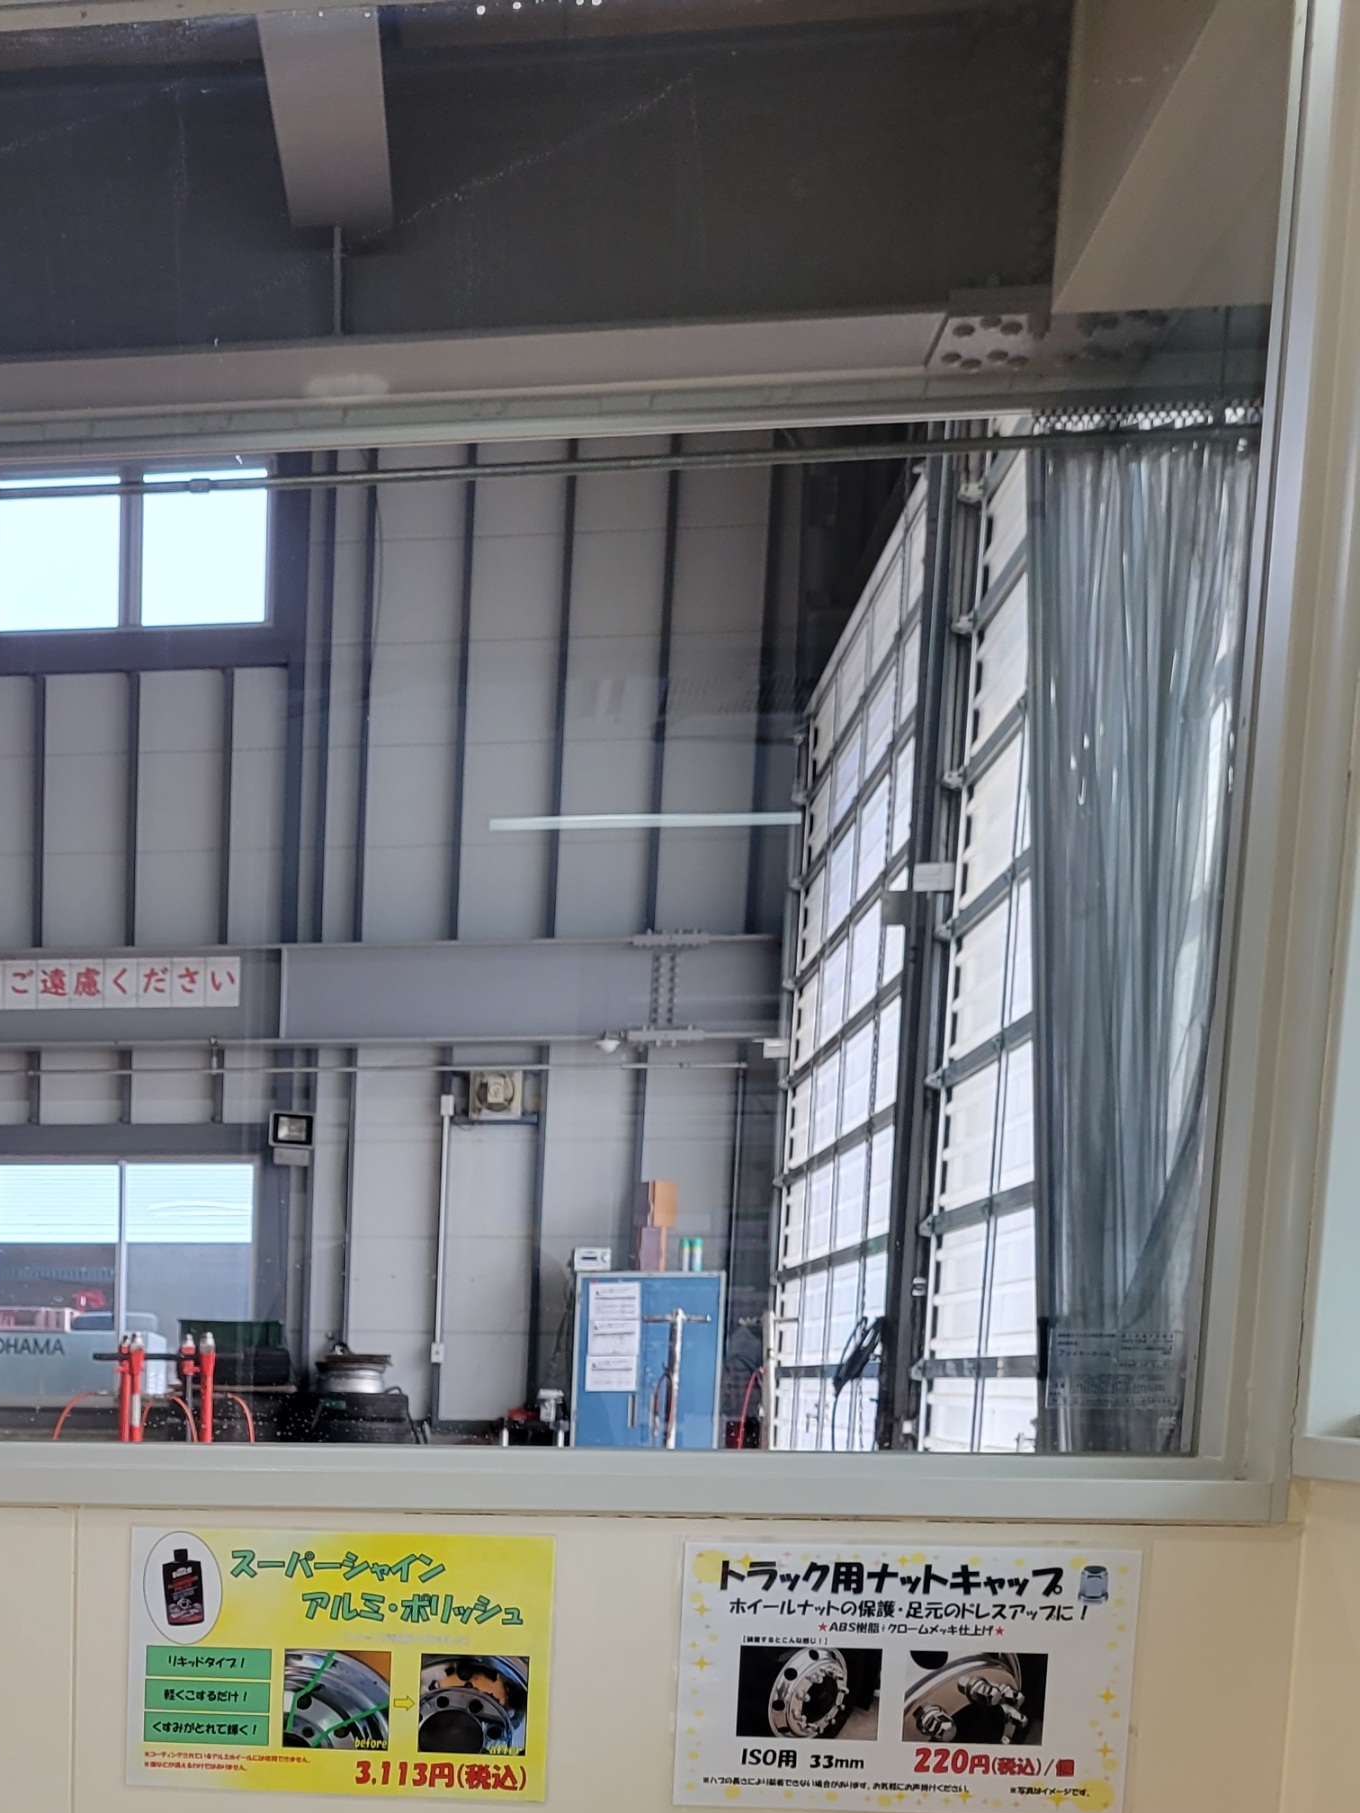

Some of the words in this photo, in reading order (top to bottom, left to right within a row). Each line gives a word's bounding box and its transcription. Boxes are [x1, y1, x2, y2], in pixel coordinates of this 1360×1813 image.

[229, 1549, 446, 1583] スーパーシャイン
[719, 1560, 1064, 1597] トラック用ナットキャップ
[301, 1591, 524, 1626] アルミ・ポリッシュ
[728, 1598, 1089, 1622] ホイールナットの保護・足元のドレスアップに！
[354, 1736, 388, 1751] before
[487, 1742, 524, 1756] after
[741, 1747, 798, 1768] ISO用
[809, 1754, 865, 1770] 33mm
